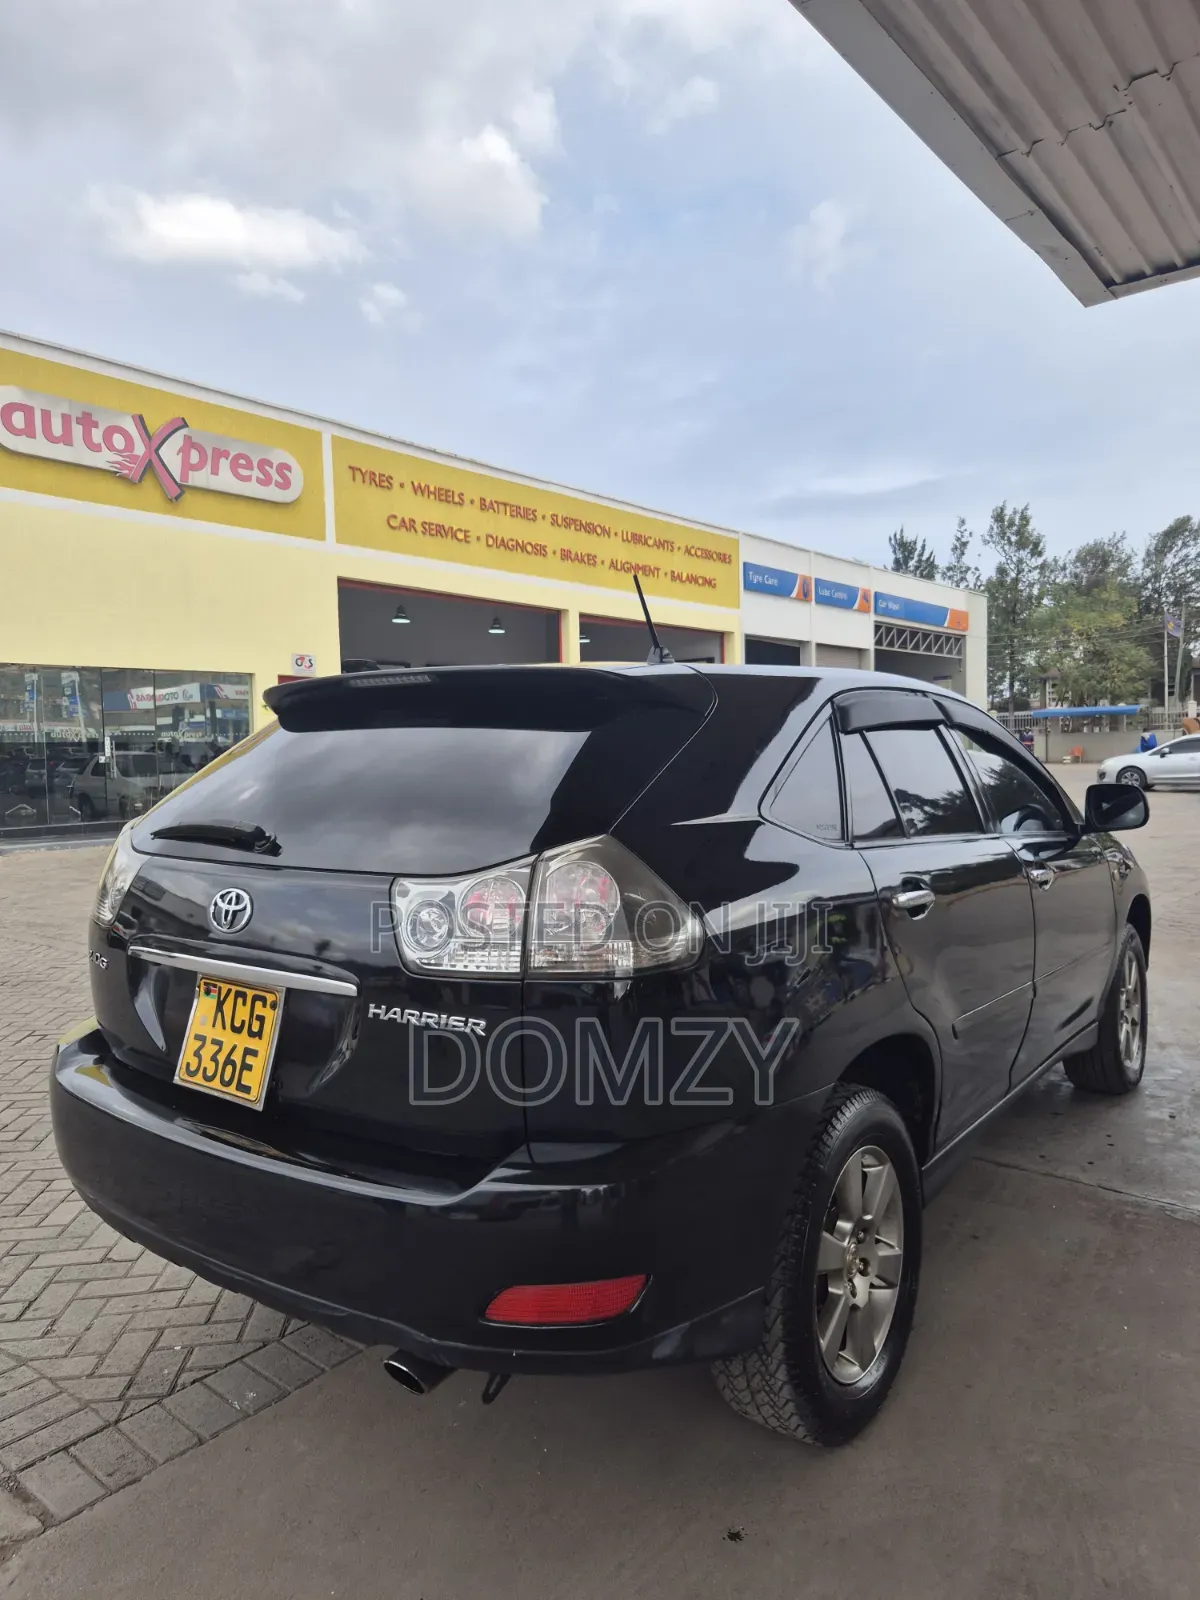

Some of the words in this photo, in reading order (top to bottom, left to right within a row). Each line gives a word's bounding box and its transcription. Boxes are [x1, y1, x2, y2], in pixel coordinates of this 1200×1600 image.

[348, 466, 393, 490] TYRES
[411, 481, 465, 506] WHEELS
[479, 497, 538, 522] BATTERIES
[550, 513, 611, 539] SUSPENSION
[621, 530, 675, 552] LUBRICANTS
[683, 545, 732, 564] ACCESSORIES
[386, 514, 418, 534] CAR
[421, 521, 471, 544] SERVICE
[485, 534, 548, 557] DIAGNOSIS
[560, 548, 598, 567] BRAKES
[609, 558, 661, 579] ALIGNMENT
[670, 570, 717, 588] BALANCING
[748, 571, 763, 584] Tyre
[764, 575, 778, 587] Care
[212, 986, 268, 1040] KCG
[368, 1003, 487, 1037] HARRIER
[185, 1033, 259, 1095] 336E
